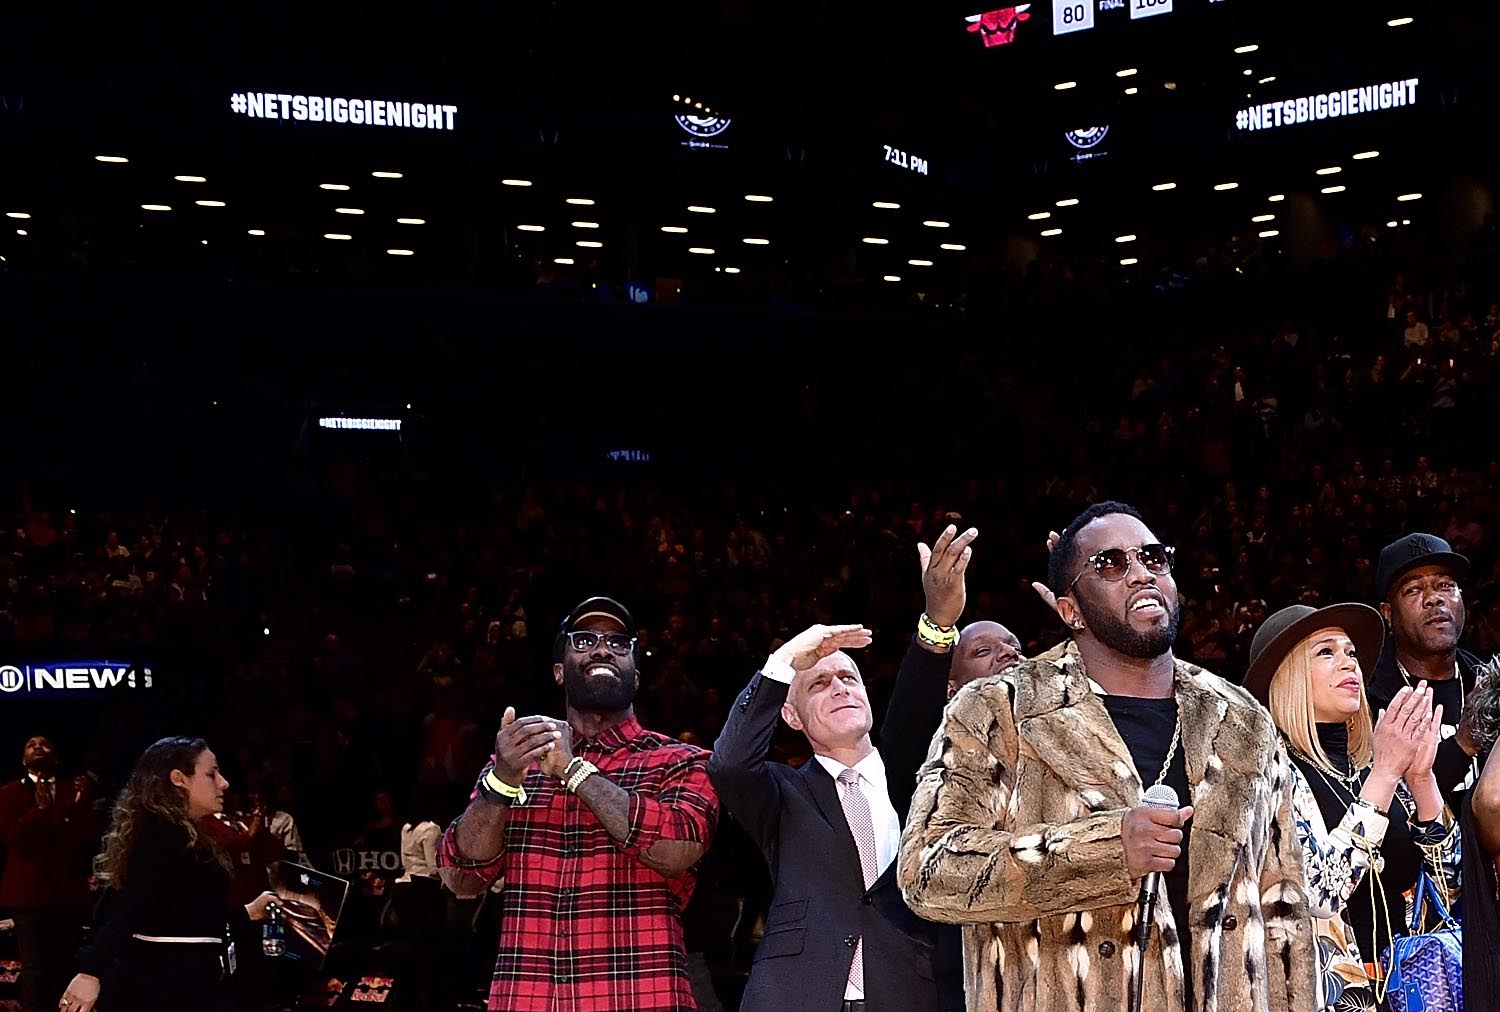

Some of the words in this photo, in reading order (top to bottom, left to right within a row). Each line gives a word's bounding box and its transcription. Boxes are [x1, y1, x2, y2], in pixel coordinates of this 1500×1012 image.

[1063, 4, 1084, 24] 80
[230, 91, 458, 131] #NETSBIGGIENIGHT
[1235, 77, 1419, 132] #NETSBIGGIENIGHT
[883, 144, 909, 169] 7:11
[910, 155, 929, 176] PM
